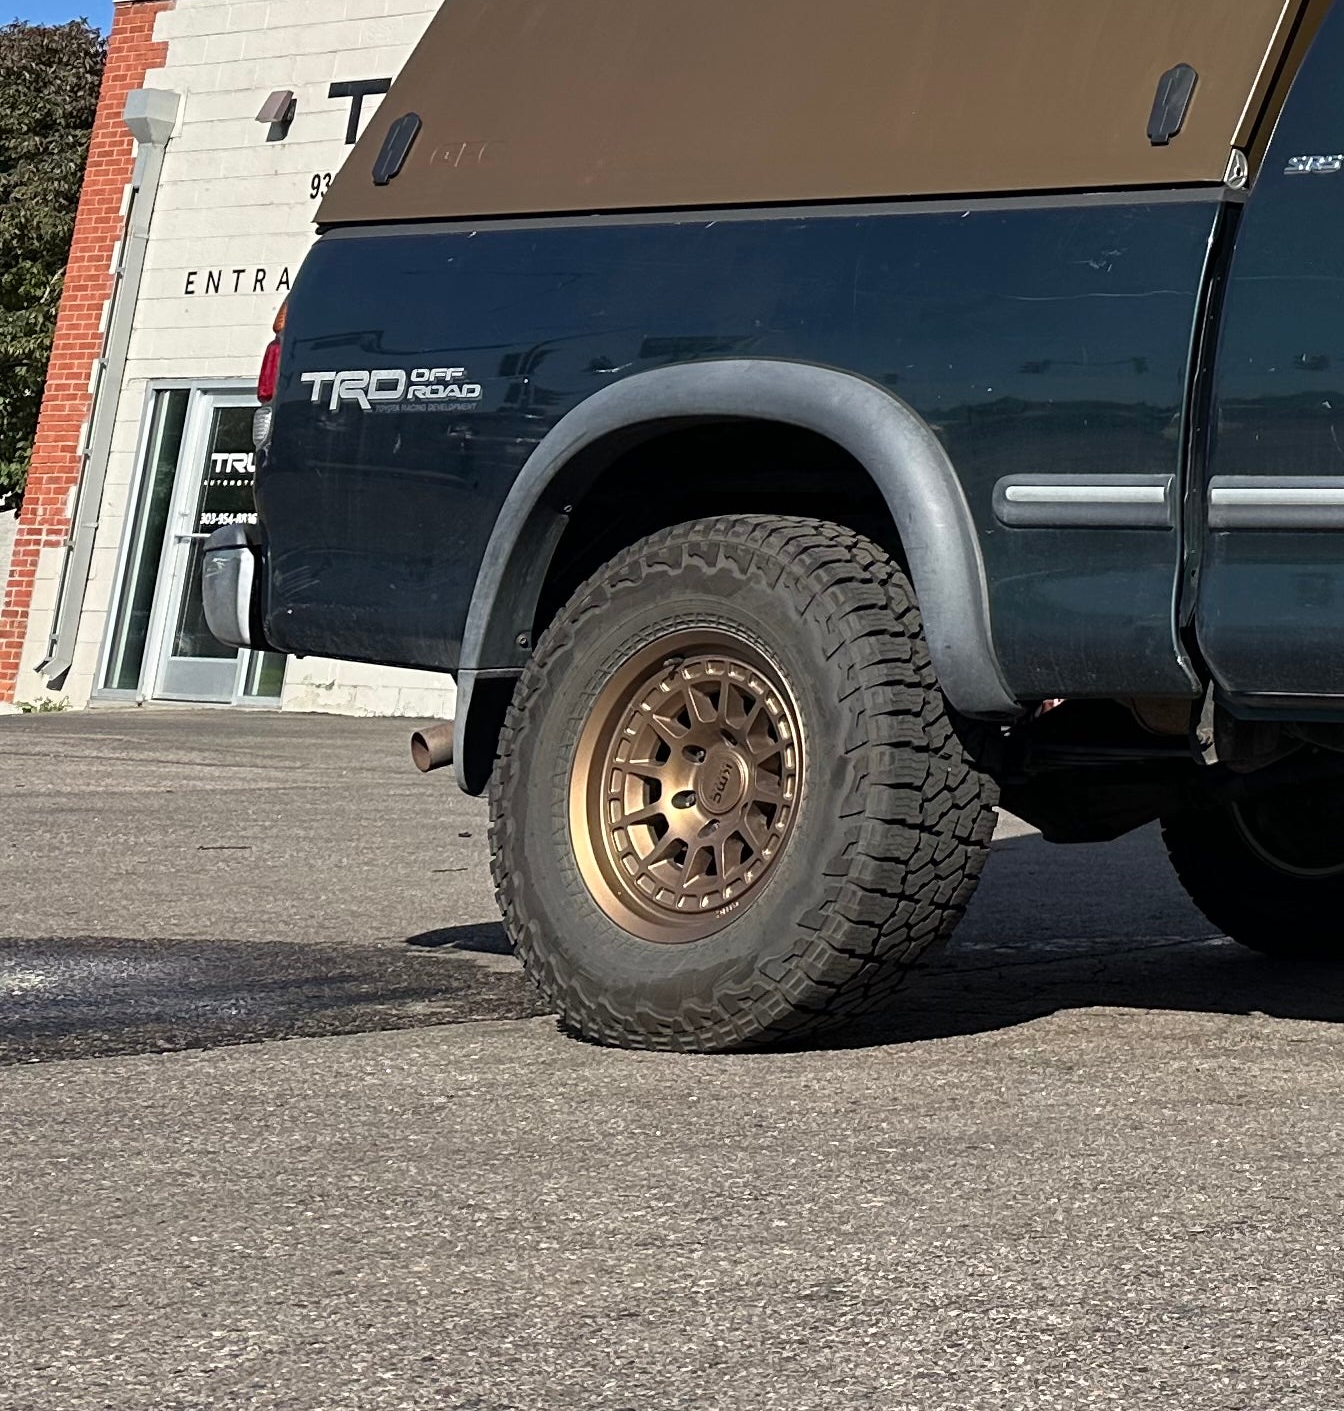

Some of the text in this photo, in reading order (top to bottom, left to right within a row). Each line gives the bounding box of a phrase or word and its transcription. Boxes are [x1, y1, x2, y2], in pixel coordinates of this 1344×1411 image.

[411, 368, 466, 382] OFF
[301, 369, 406, 411] TRD
[407, 384, 482, 400] ROAD
